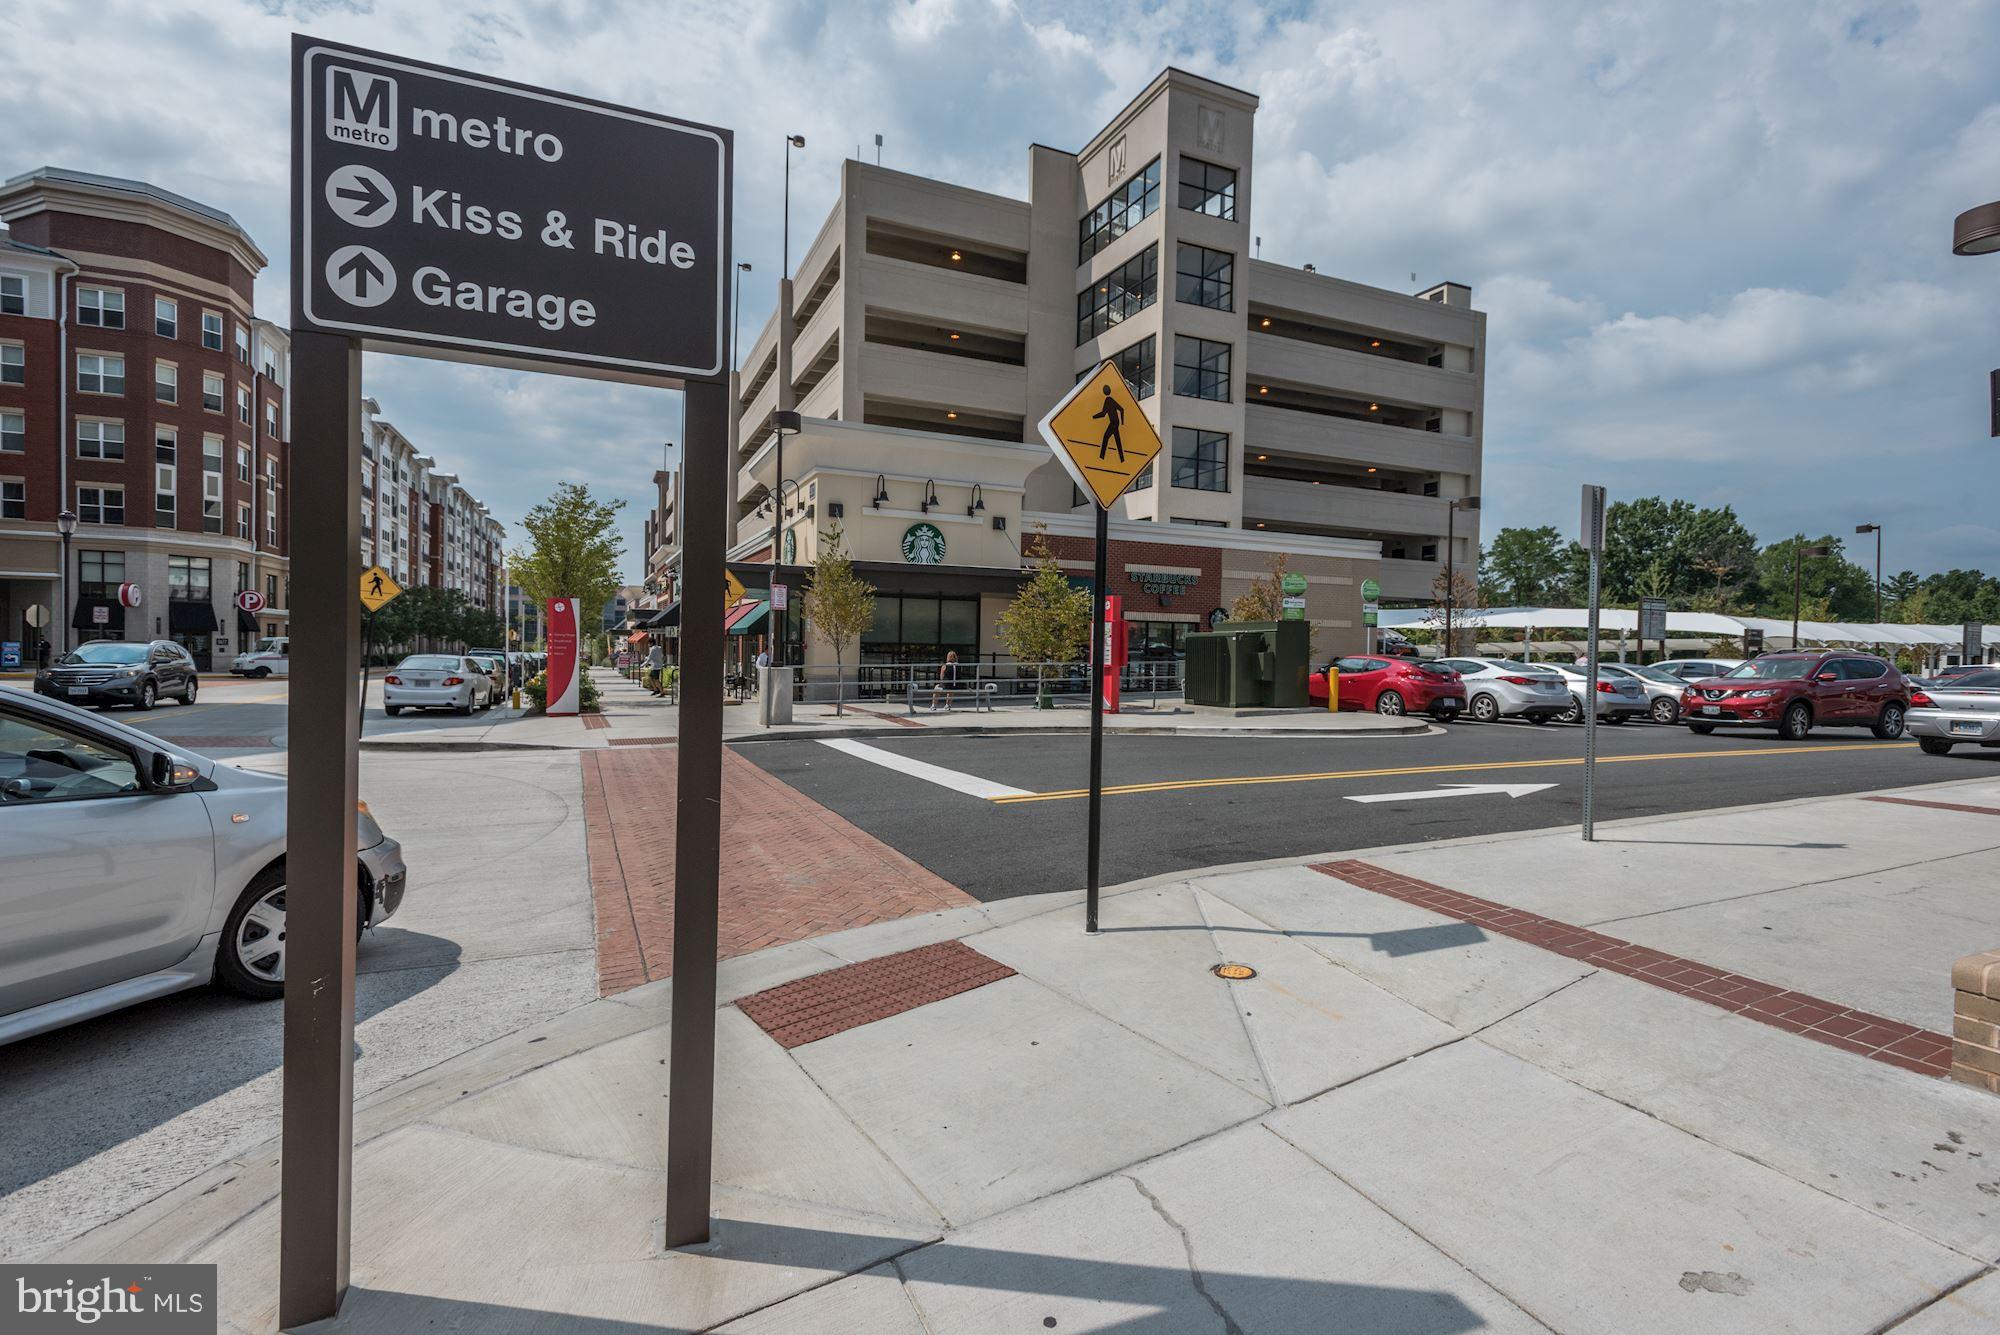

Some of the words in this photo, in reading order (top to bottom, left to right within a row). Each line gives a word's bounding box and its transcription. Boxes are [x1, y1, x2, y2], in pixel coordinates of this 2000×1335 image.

[333, 69, 391, 129] M
[333, 124, 390, 146] metro
[412, 107, 564, 163] metro
[412, 185, 523, 241] Kiss
[540, 209, 576, 250] &
[594, 217, 696, 270] Ride
[411, 265, 597, 331] Garage
[244, 593, 258, 609] P
[1143, 582, 1186, 596] COFFEE
